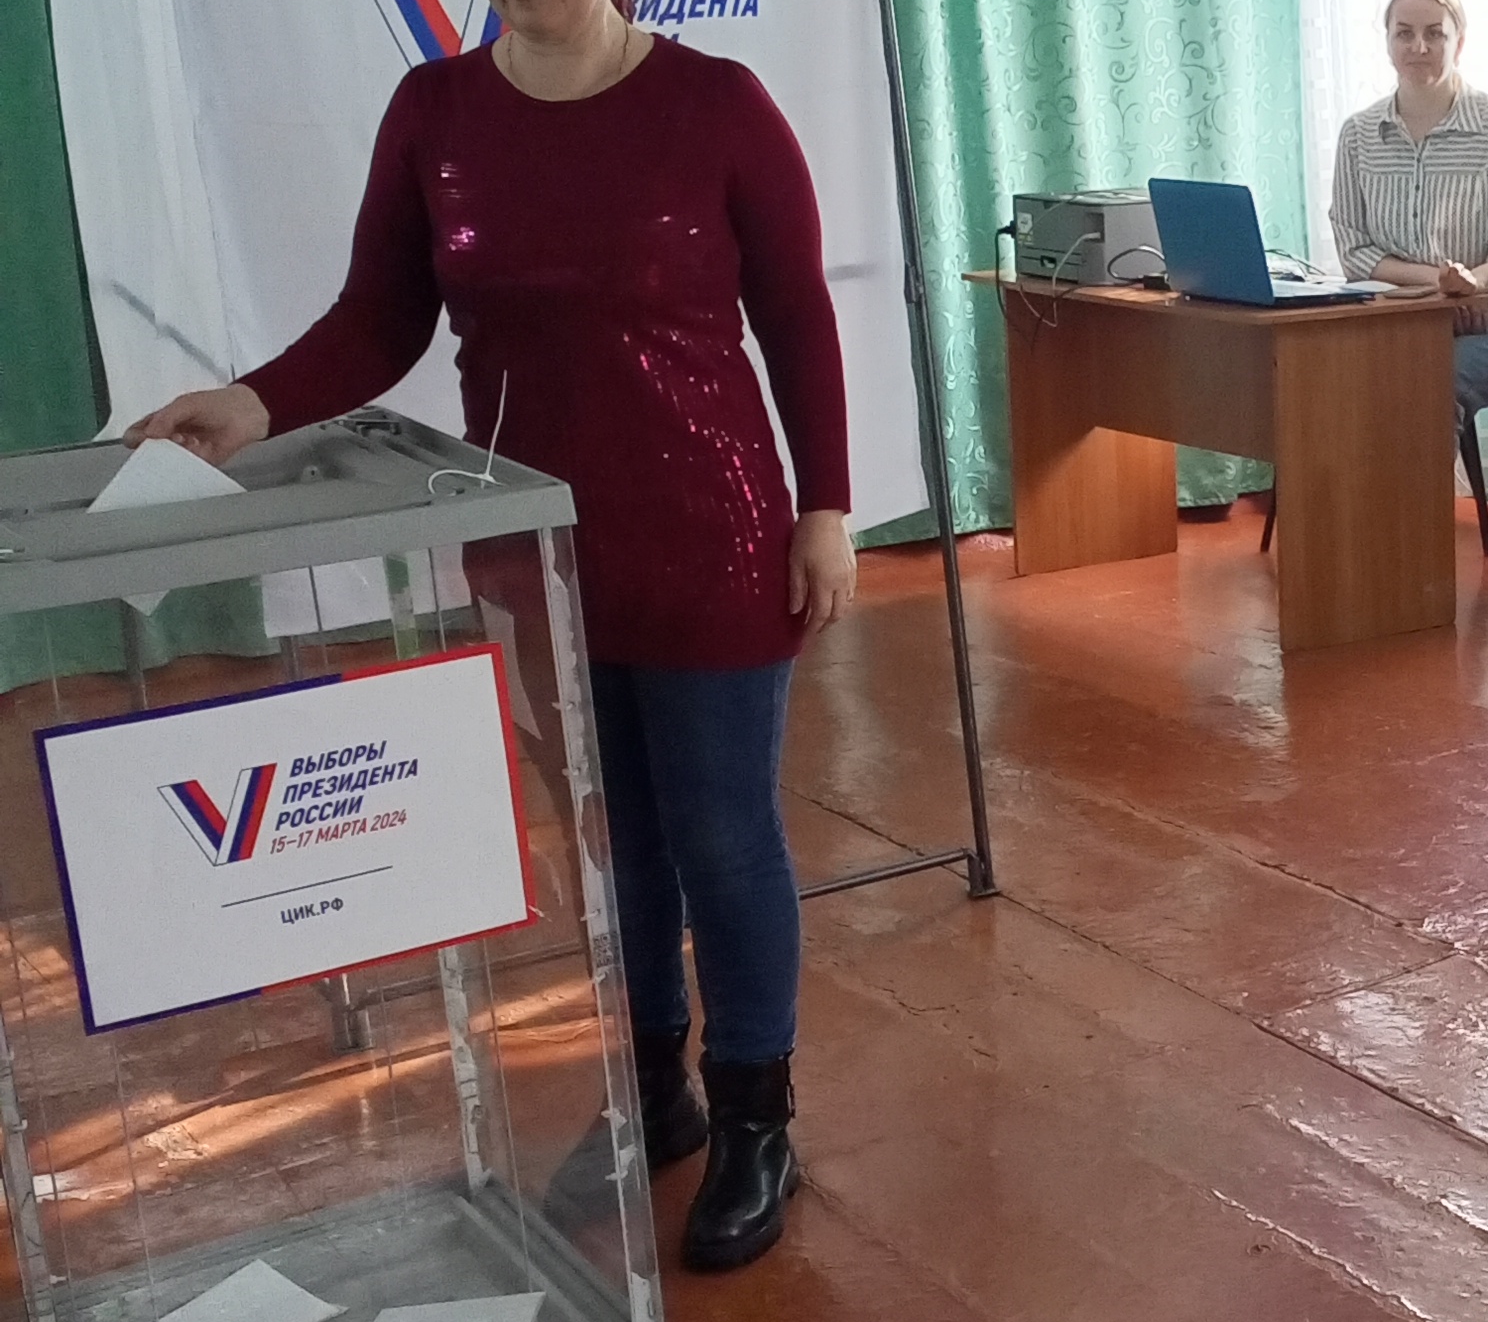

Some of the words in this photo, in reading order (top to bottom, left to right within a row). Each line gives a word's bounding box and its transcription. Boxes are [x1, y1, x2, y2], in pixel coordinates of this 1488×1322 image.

[289, 740, 387, 778] ВЫБОРЫ
[282, 758, 418, 805] ПРЕЗИДЕНТА
[275, 795, 364, 832] РОССИИ
[315, 818, 368, 845] МАРТА
[370, 809, 407, 833] 2024
[280, 897, 344, 924] ЦИК.РФ
